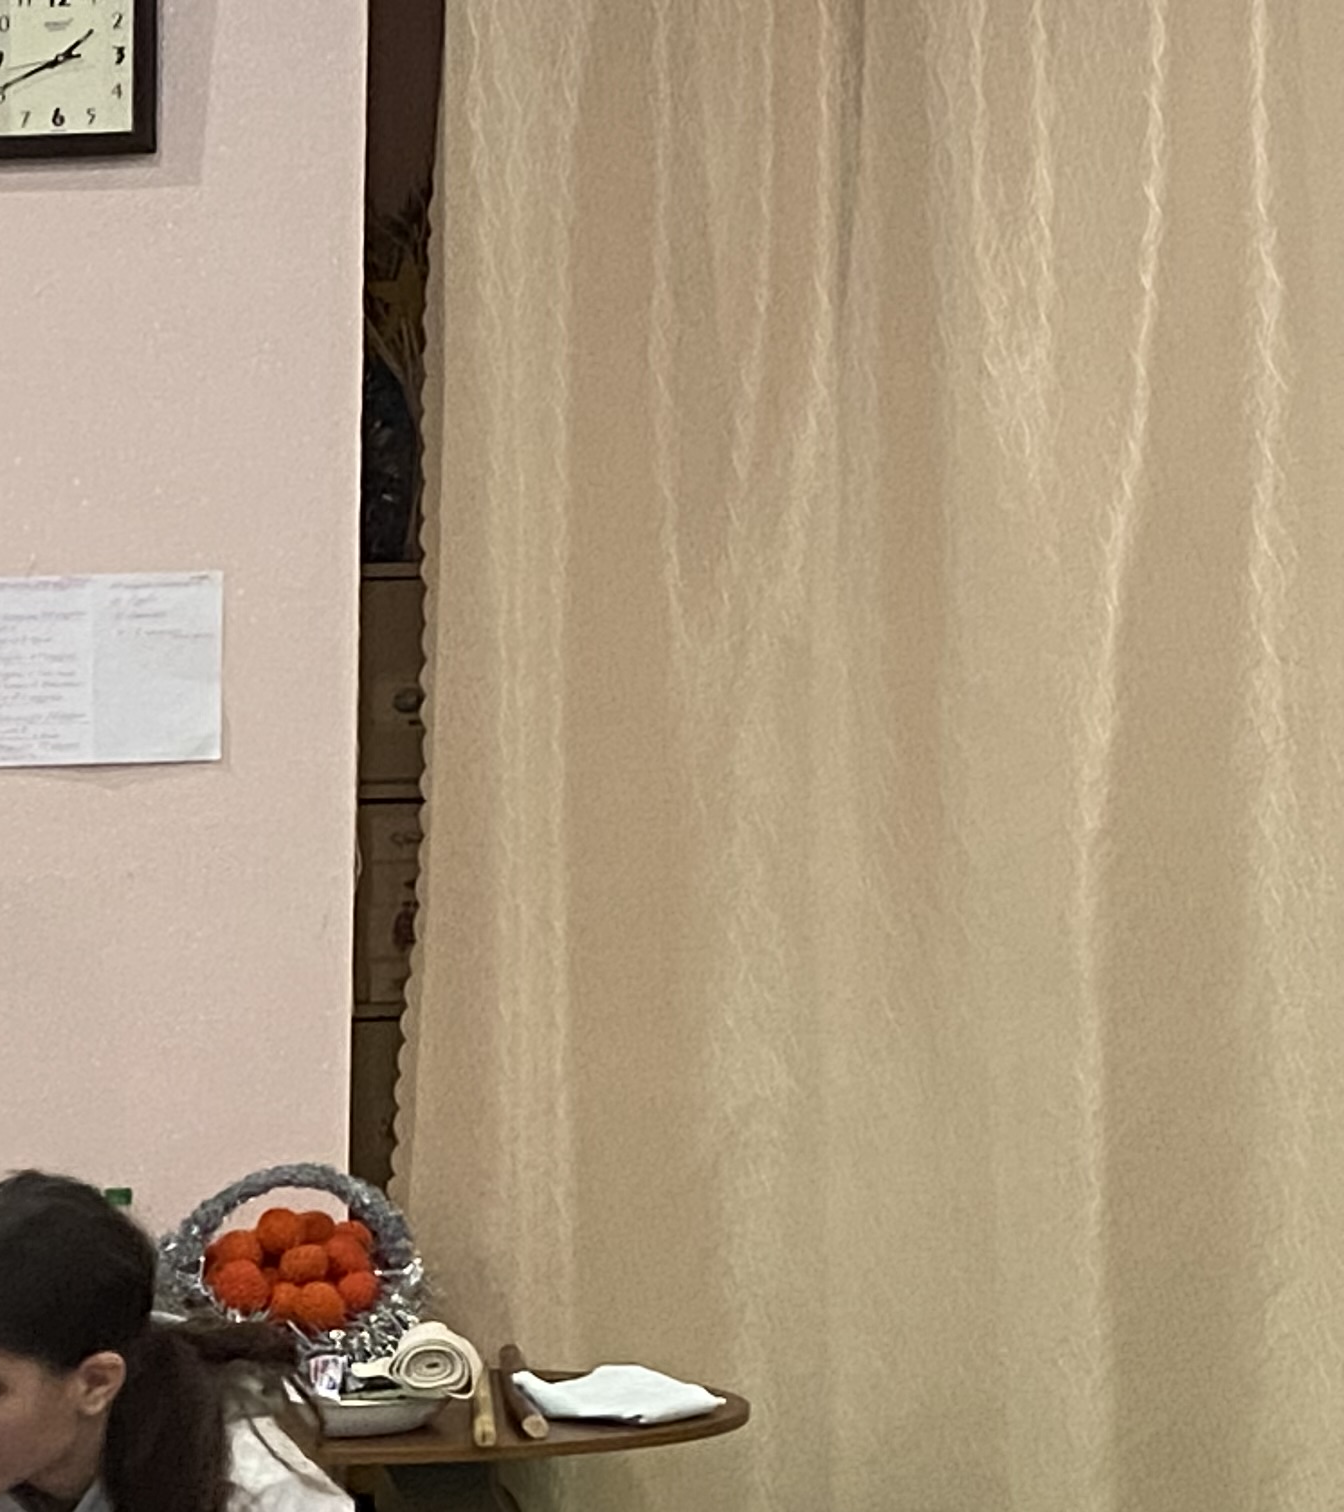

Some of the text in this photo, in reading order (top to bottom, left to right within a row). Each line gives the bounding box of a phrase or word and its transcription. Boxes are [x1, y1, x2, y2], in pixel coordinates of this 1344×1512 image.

[112, 12, 123, 29] 2
[113, 46, 125, 65] 3
[112, 83, 123, 100] 4
[21, 110, 31, 128] 7
[51, 107, 65, 126] 6
[86, 107, 96, 125] 5
